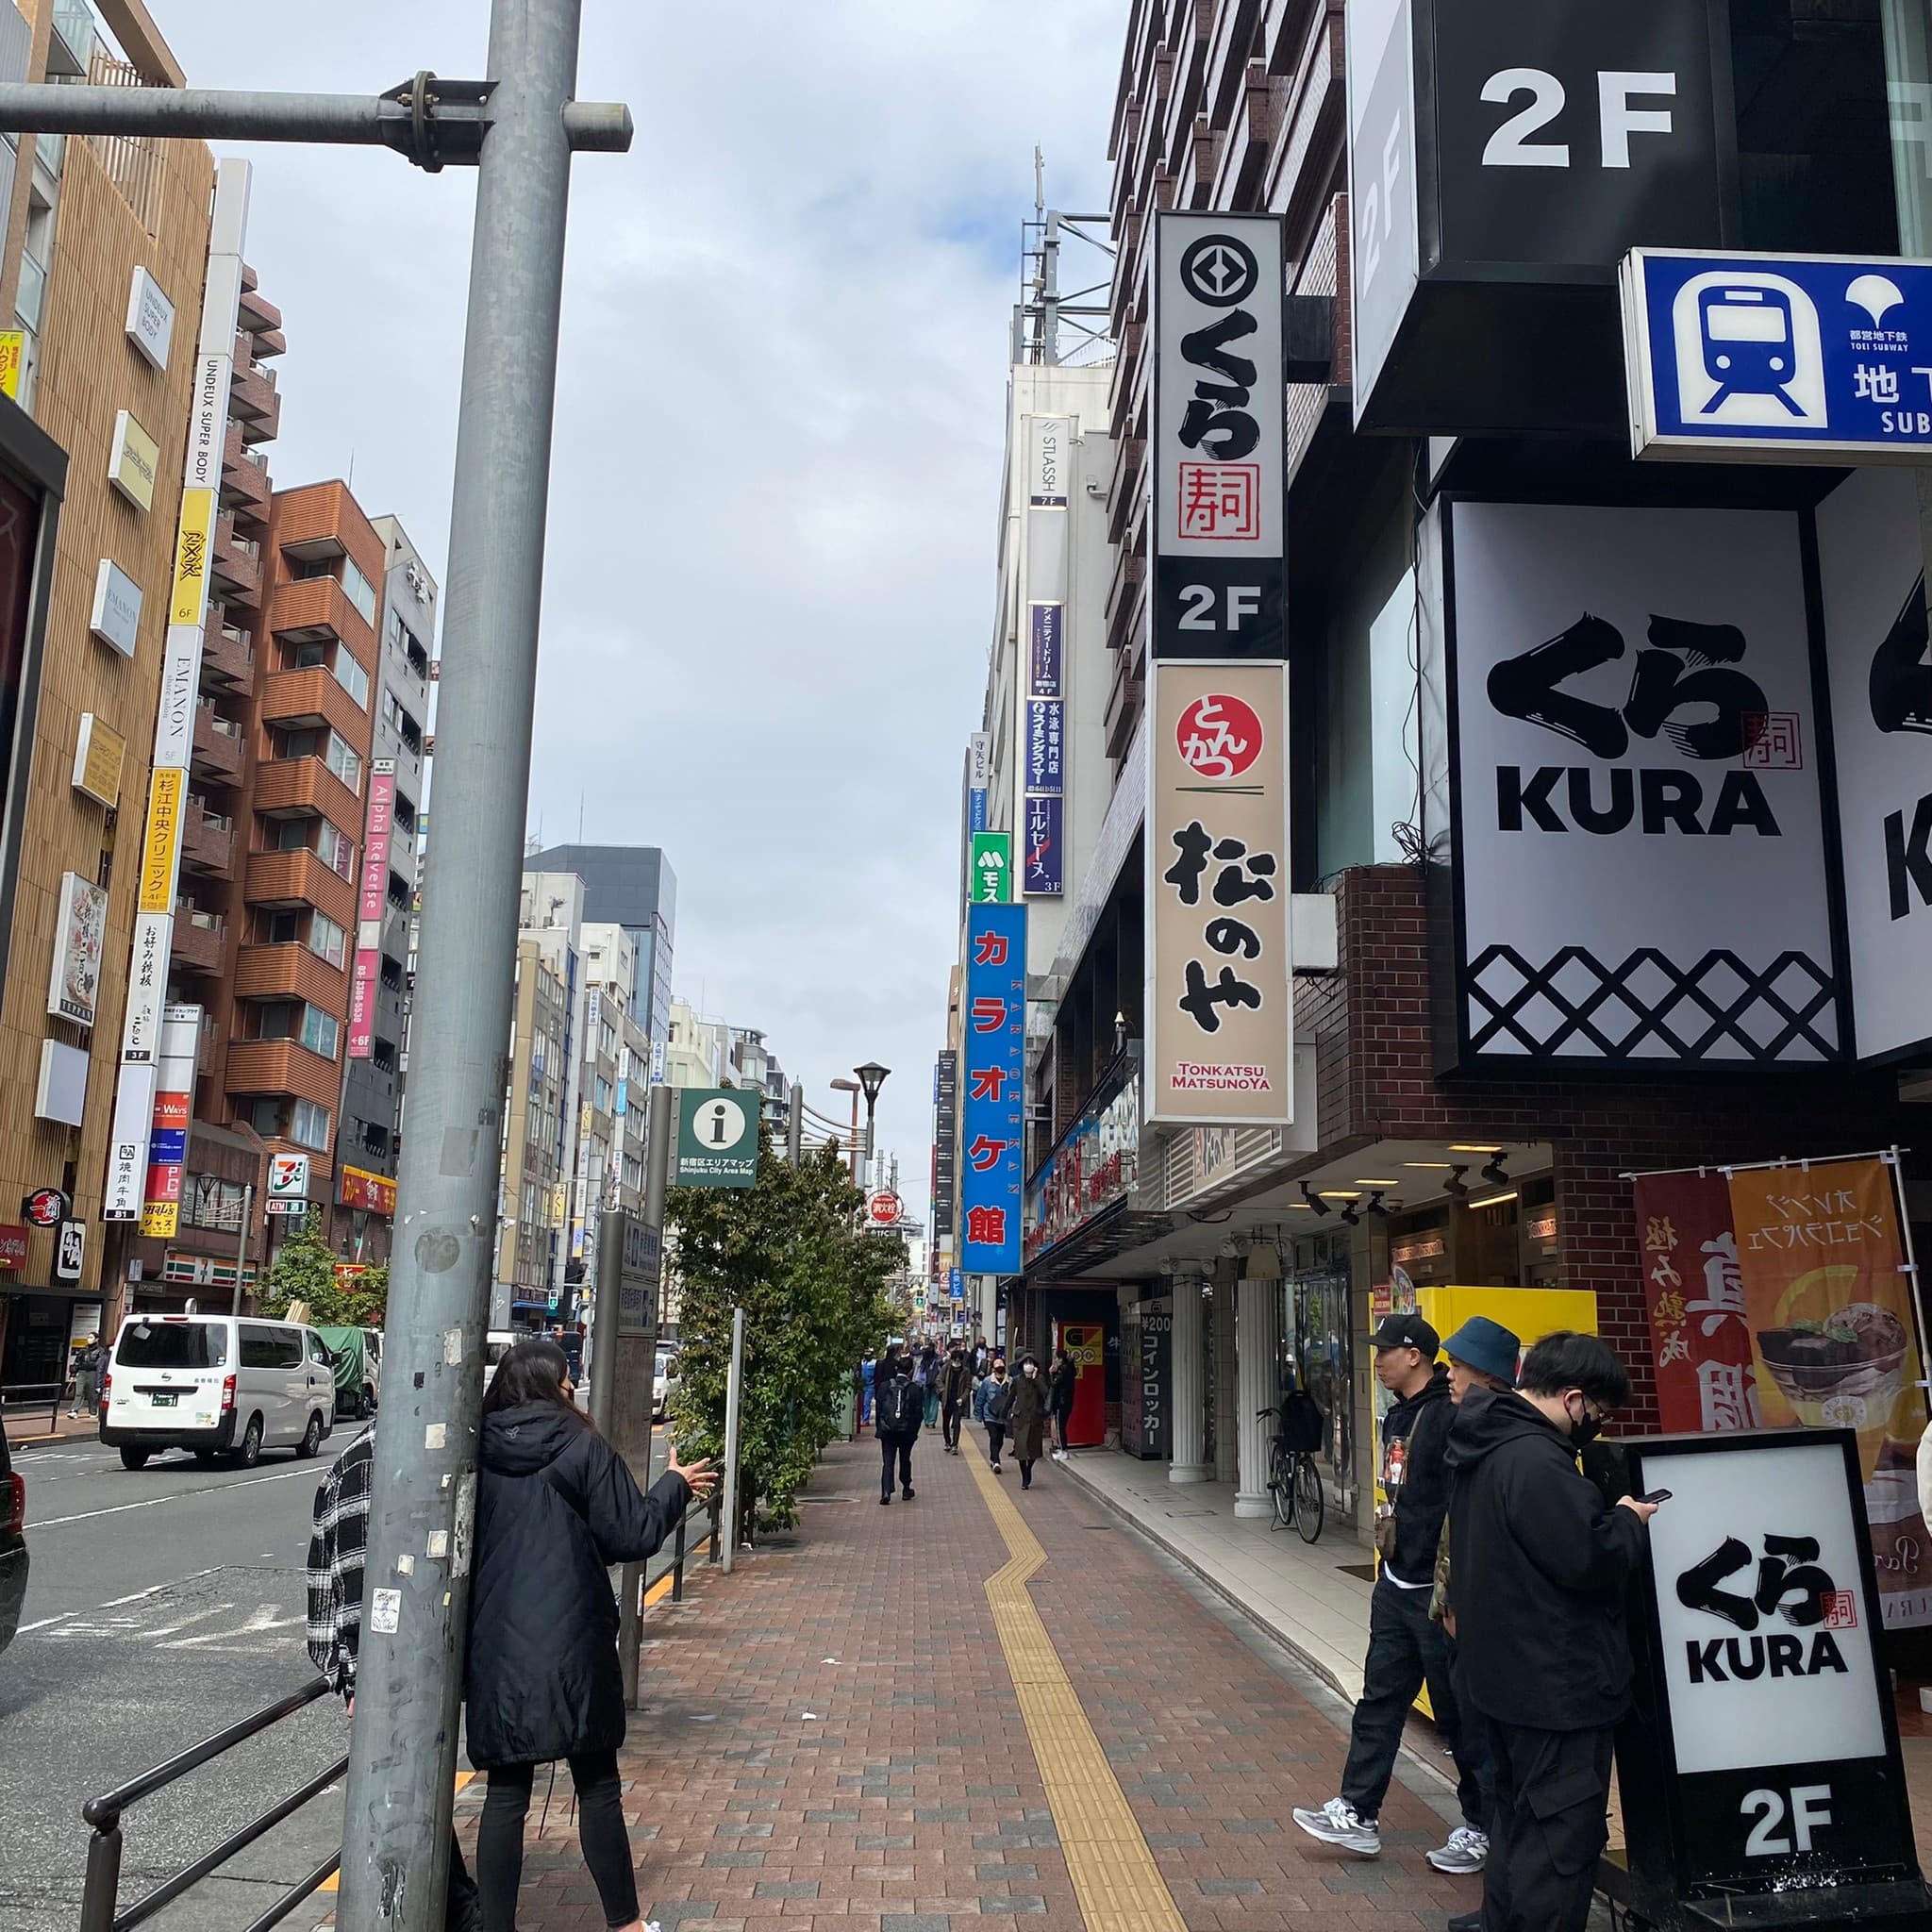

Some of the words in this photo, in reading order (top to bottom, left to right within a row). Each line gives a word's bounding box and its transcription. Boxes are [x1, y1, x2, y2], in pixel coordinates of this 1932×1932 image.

[1479, 67, 1676, 168] 2F
[1850, 330, 1907, 341] 都営地下鉄
[1851, 342, 1870, 351] TOEI
[1873, 343, 1908, 352] SUBWAY
[201, 359, 218, 407] UNDEUX
[1177, 307, 1261, 460] くら
[198, 412, 212, 446] SUPER
[195, 451, 208, 483] BODY
[1042, 437, 1056, 491] STLASSH
[1041, 497, 1056, 506] 7F
[1186, 469, 1251, 533] 寿司
[178, 608, 192, 619] 6F
[1177, 584, 1261, 632] 2F
[170, 657, 191, 739] EMANON
[1487, 611, 1770, 760] くら
[1182, 693, 1249, 780] とんかつ
[1747, 715, 1797, 764] 寿司
[372, 785, 389, 832] Alpha
[1496, 765, 1782, 837] KURA
[149, 779, 175, 891] 杉江中央クリニック
[366, 842, 384, 908] Reverse
[1044, 882, 1061, 892] 3F
[1164, 821, 1277, 1034] 松のや
[358, 1035, 369, 1045] 6F
[966, 931, 1009, 1246] カラオケ館
[1171, 1075, 1272, 1091] MATSUNOYA
[1177, 1063, 1267, 1076] TONKATSU
[163, 1104, 188, 1115] WAYS
[679, 1166, 708, 1175] Shinjuku
[709, 1167, 723, 1175] City
[740, 1168, 754, 1176] Map
[680, 1157, 755, 1168] 新宿区エリアマップ
[270, 1202, 286, 1212] ATM
[1141, 1316, 1171, 1332] ¥200
[1142, 1336, 1160, 1445] コインロッカー
[1676, 1533, 1837, 1631] くら
[1686, 1631, 1849, 1684] KURA
[1740, 1783, 1833, 1857] 2F
